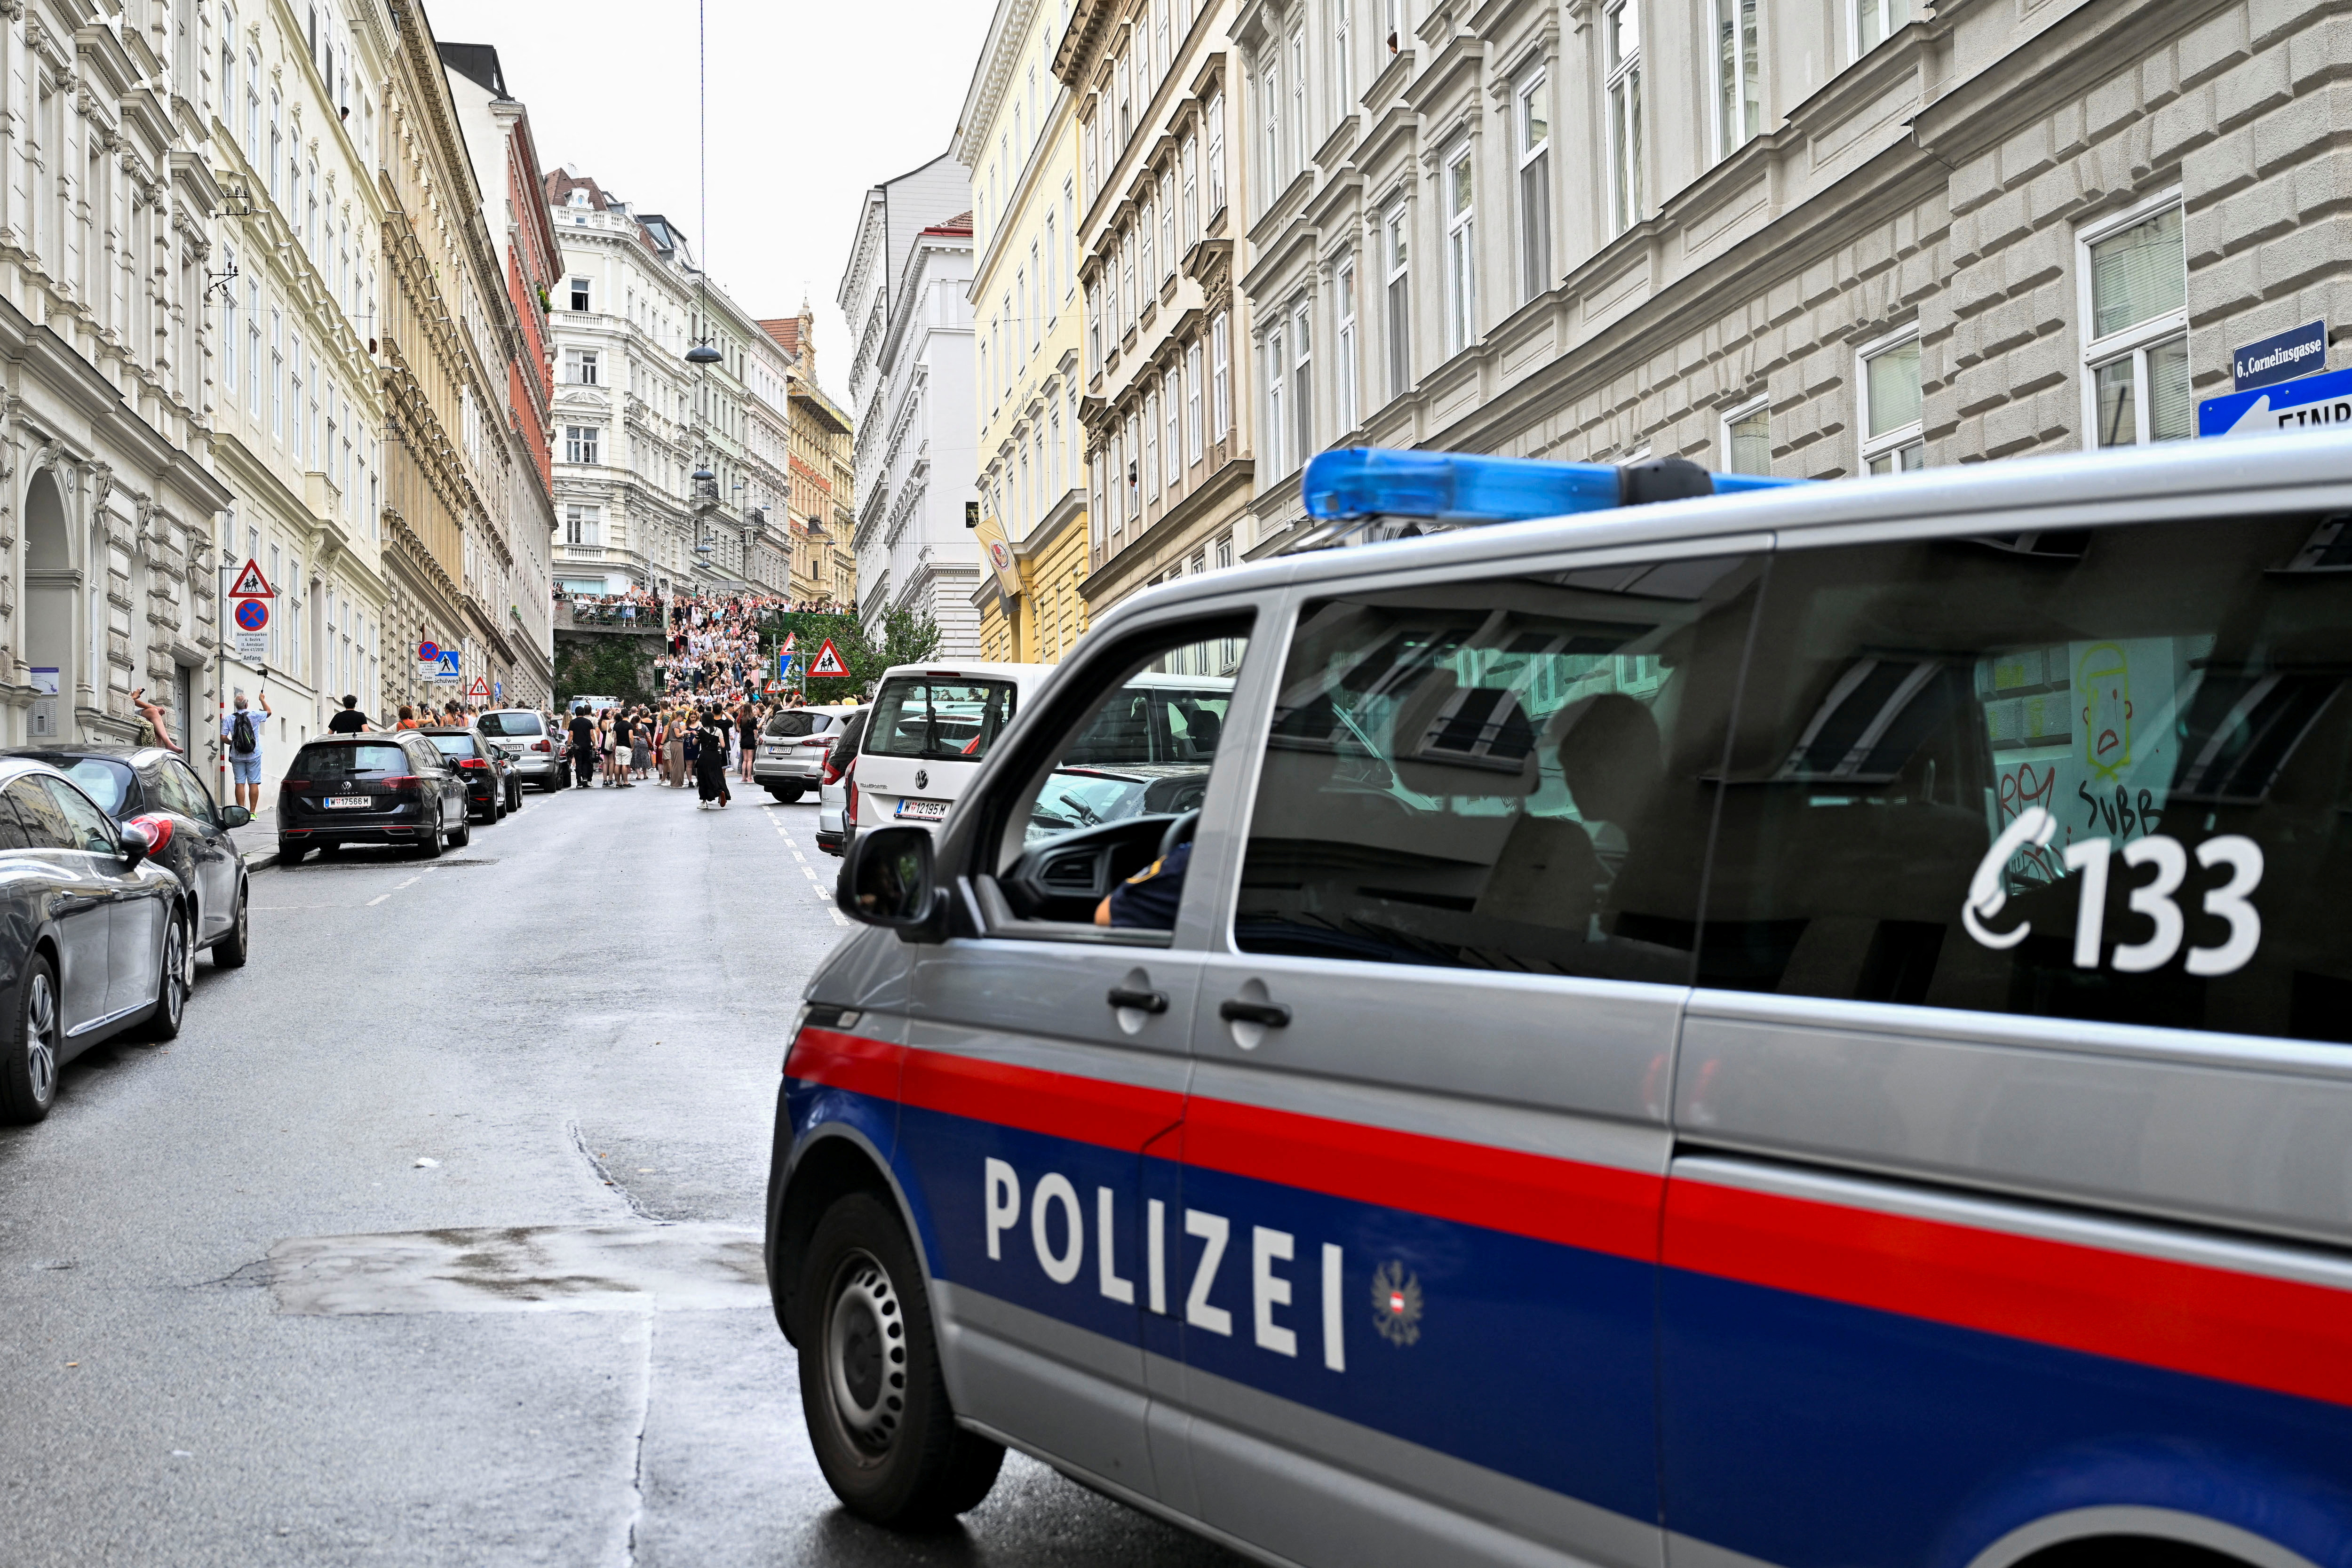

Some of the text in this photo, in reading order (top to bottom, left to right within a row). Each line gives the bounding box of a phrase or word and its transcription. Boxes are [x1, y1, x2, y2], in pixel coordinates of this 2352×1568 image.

[2249, 339, 2321, 374] Corneliusgasse
[904, 802, 912, 812] W
[916, 802, 939, 814] 12195
[2065, 835, 2264, 976] 133
[985, 1156, 1345, 1373] POLIZEI
